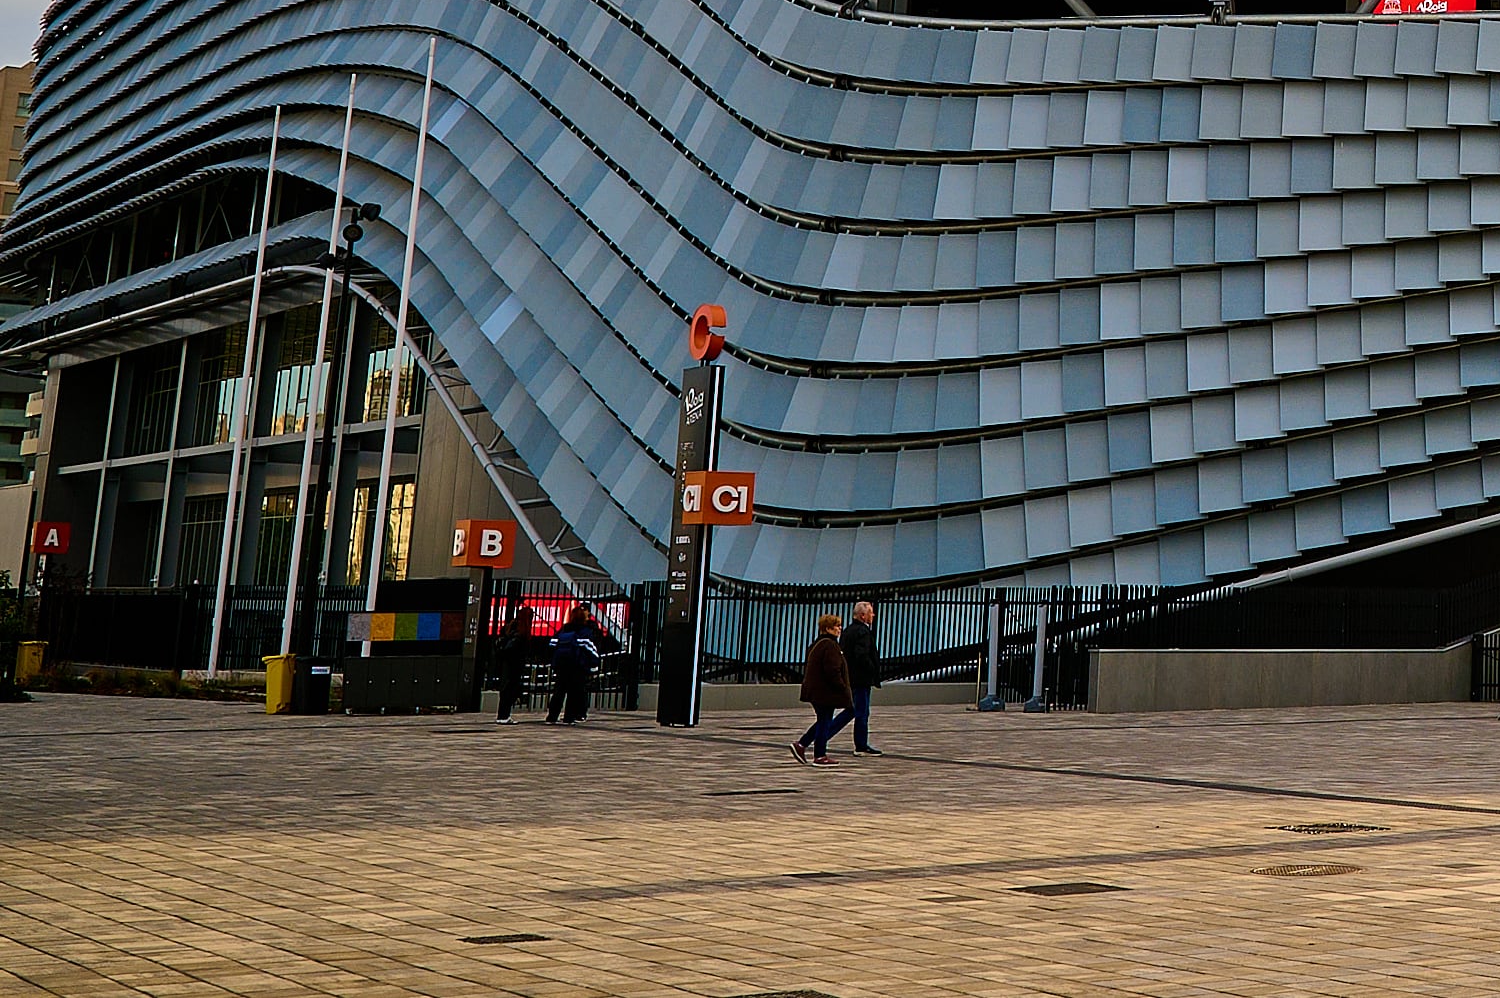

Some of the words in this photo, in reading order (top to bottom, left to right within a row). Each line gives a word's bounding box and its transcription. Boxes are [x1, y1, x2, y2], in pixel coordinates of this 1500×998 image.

[683, 484, 702, 512] C1
[712, 485, 748, 513] C1
[43, 528, 59, 547] A
[453, 529, 465, 557] B
[480, 529, 503, 557] B
